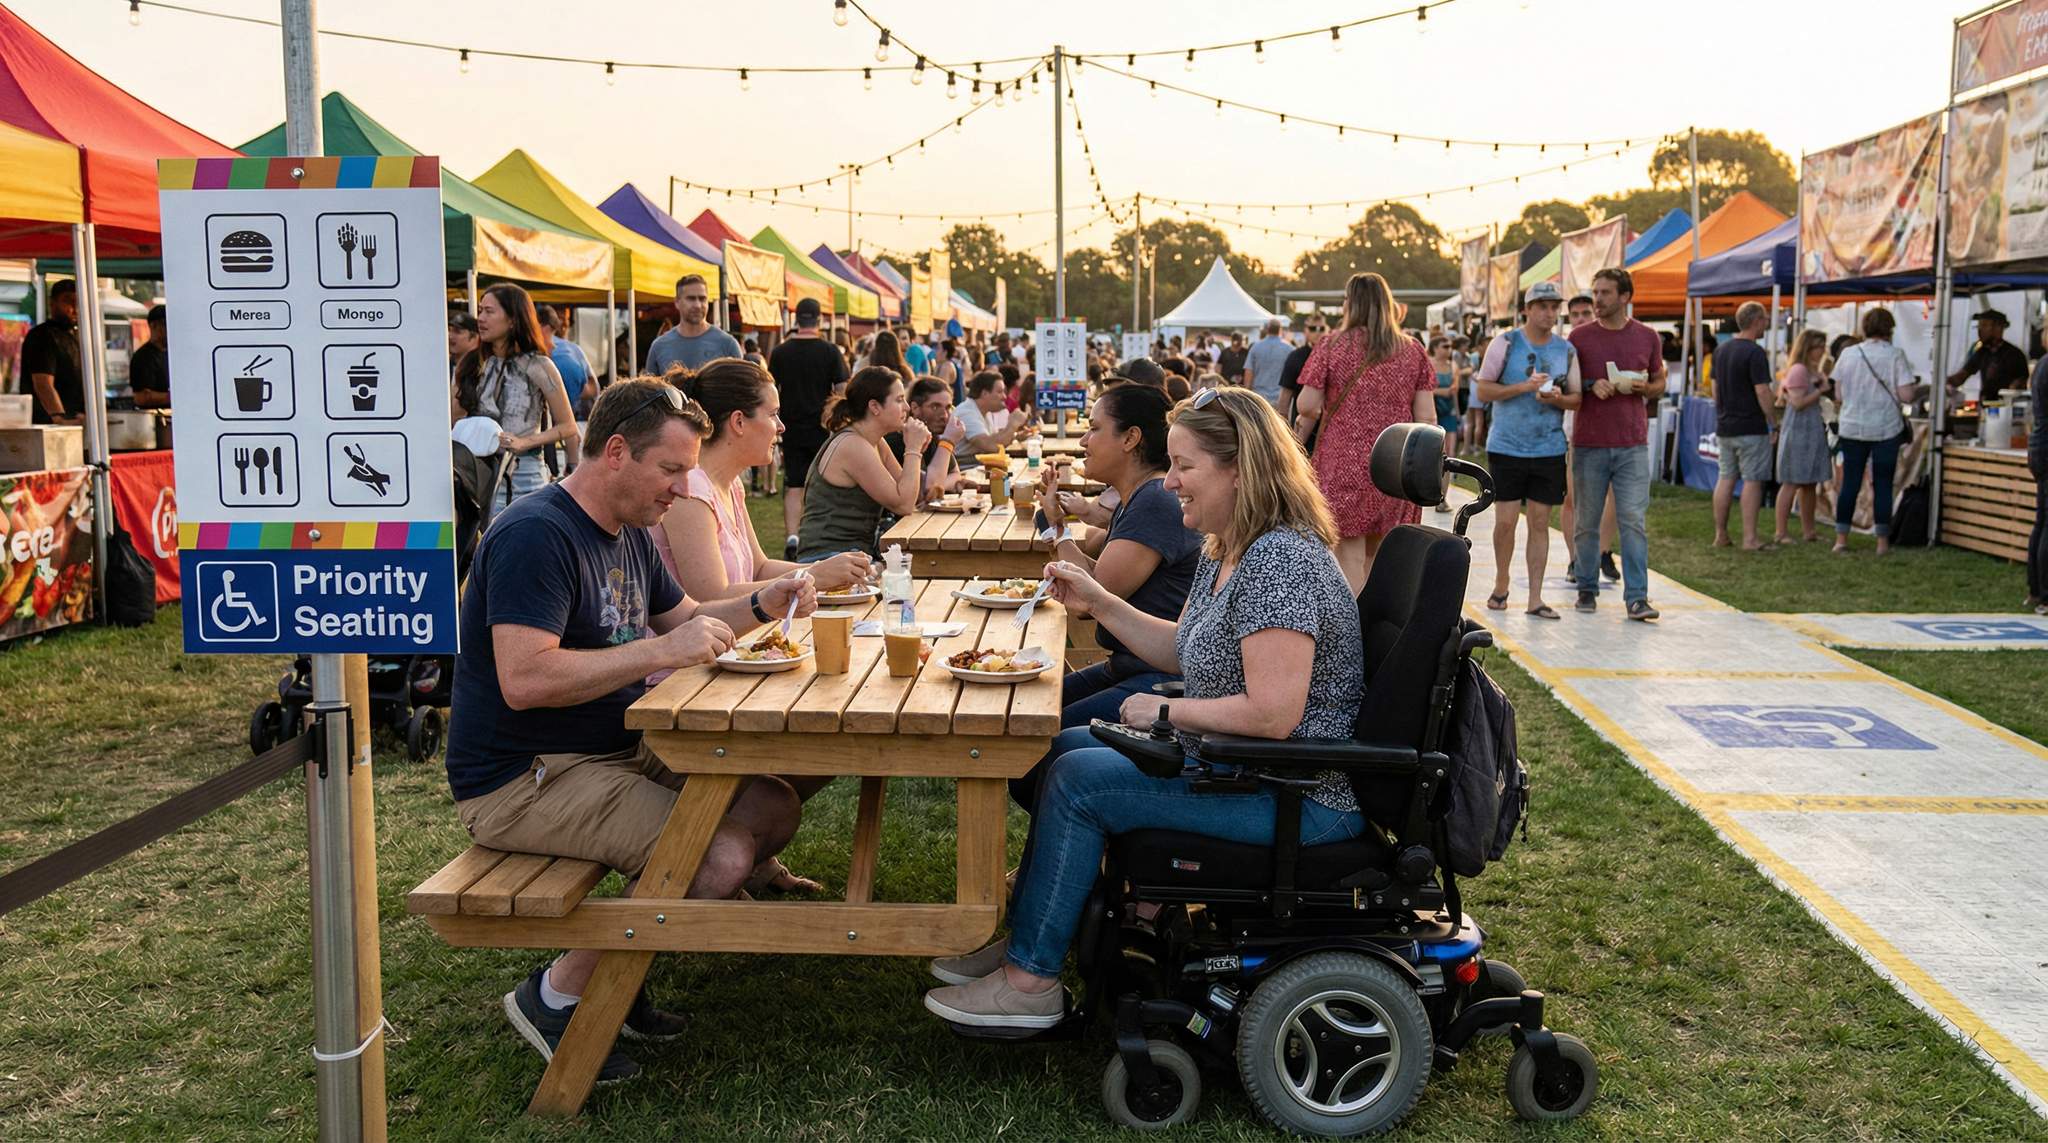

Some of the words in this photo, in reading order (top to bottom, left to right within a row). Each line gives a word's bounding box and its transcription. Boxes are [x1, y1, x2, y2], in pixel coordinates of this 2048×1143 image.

[230, 310, 270, 320] Merea
[338, 309, 383, 321] Mongo
[293, 564, 428, 603] Priority
[294, 606, 434, 645] Seating
